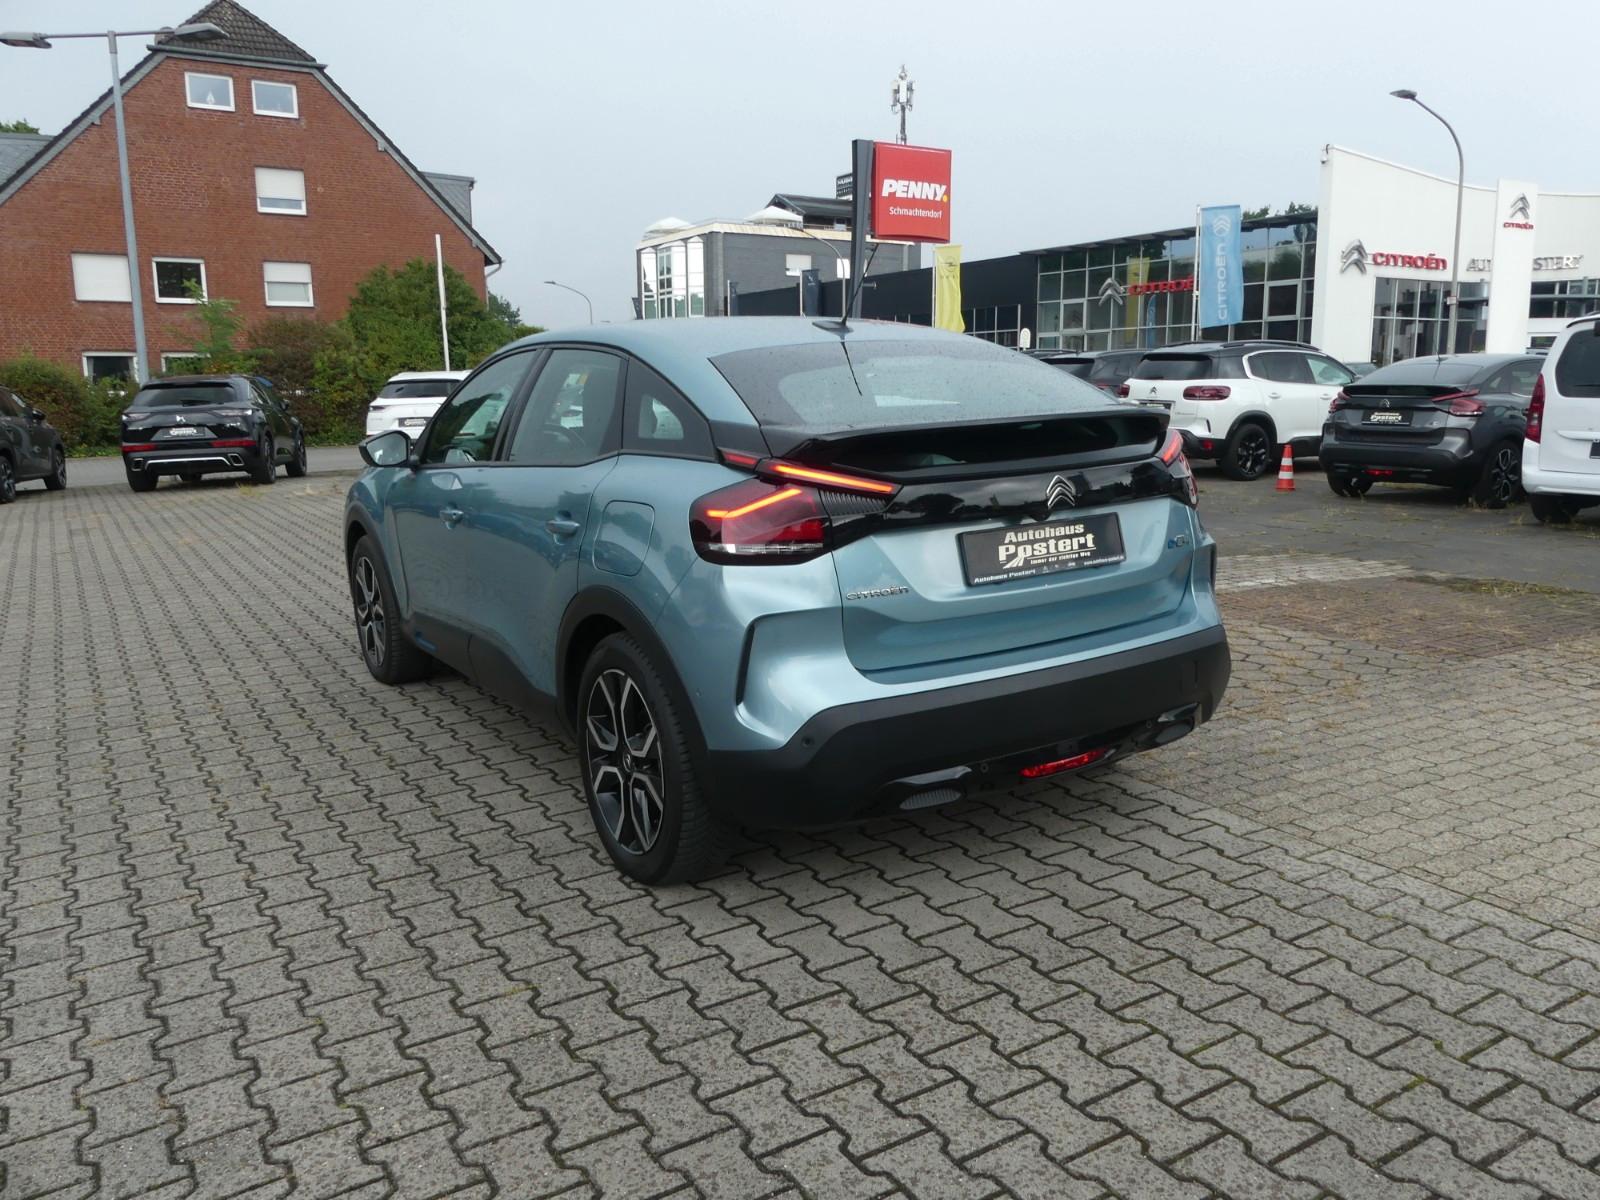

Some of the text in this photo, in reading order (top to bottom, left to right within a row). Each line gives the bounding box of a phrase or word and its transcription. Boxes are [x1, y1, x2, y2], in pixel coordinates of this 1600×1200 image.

[889, 206, 943, 219] Schmachtendorf
[1004, 523, 1084, 544] Autohaus
[998, 533, 1096, 564] Postert
[974, 573, 1008, 583] Autohaus
